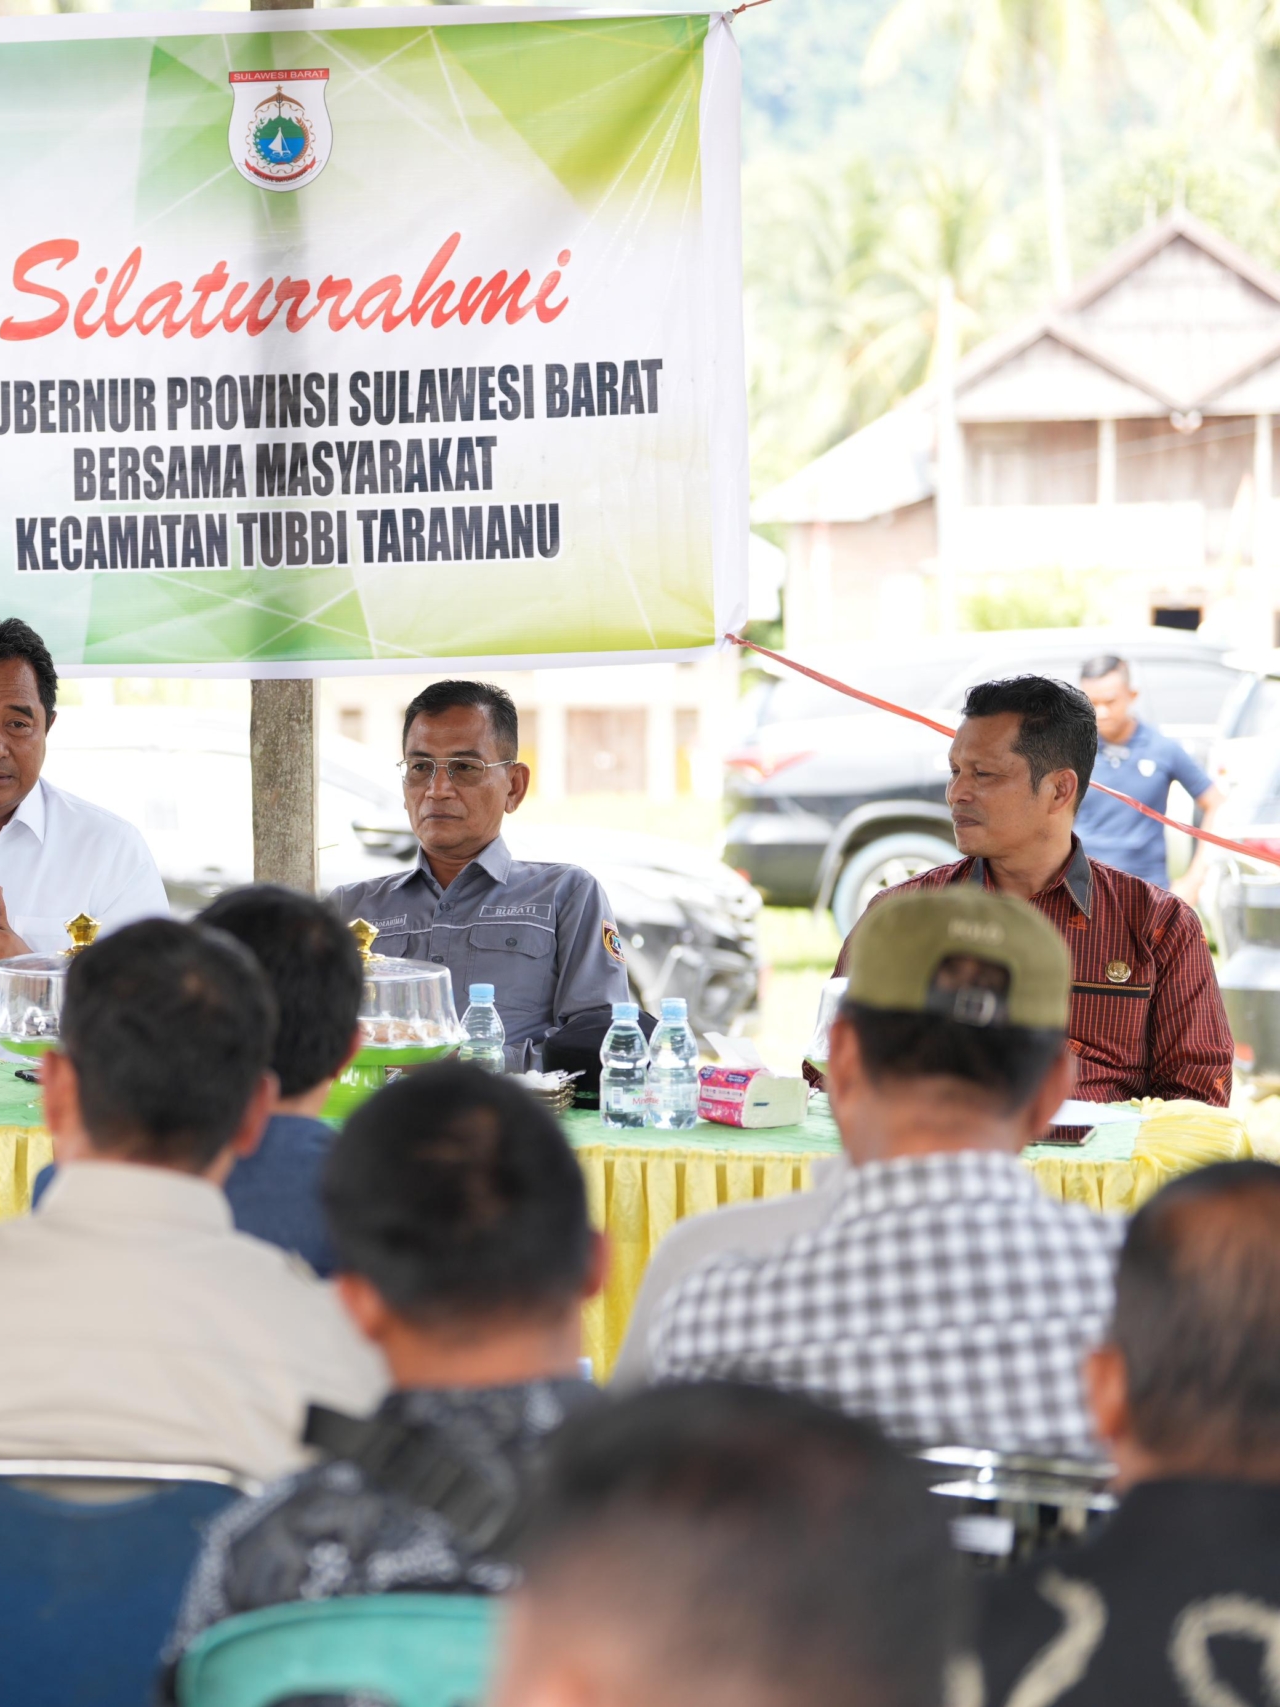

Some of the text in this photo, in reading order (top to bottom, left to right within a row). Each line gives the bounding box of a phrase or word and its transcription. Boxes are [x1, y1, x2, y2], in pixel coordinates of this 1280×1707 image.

[233, 69, 325, 81] SULAWESI BARAT
[166, 372, 339, 432] PROVINSI
[348, 363, 535, 427] SULAWESI
[545, 358, 663, 419] BARAT
[72, 435, 497, 502] BERSAMA MASYARAKAT
[15, 502, 561, 571] KECAMATAN TUBBI TARAMANU
[494, 904, 537, 917] BUPATI
